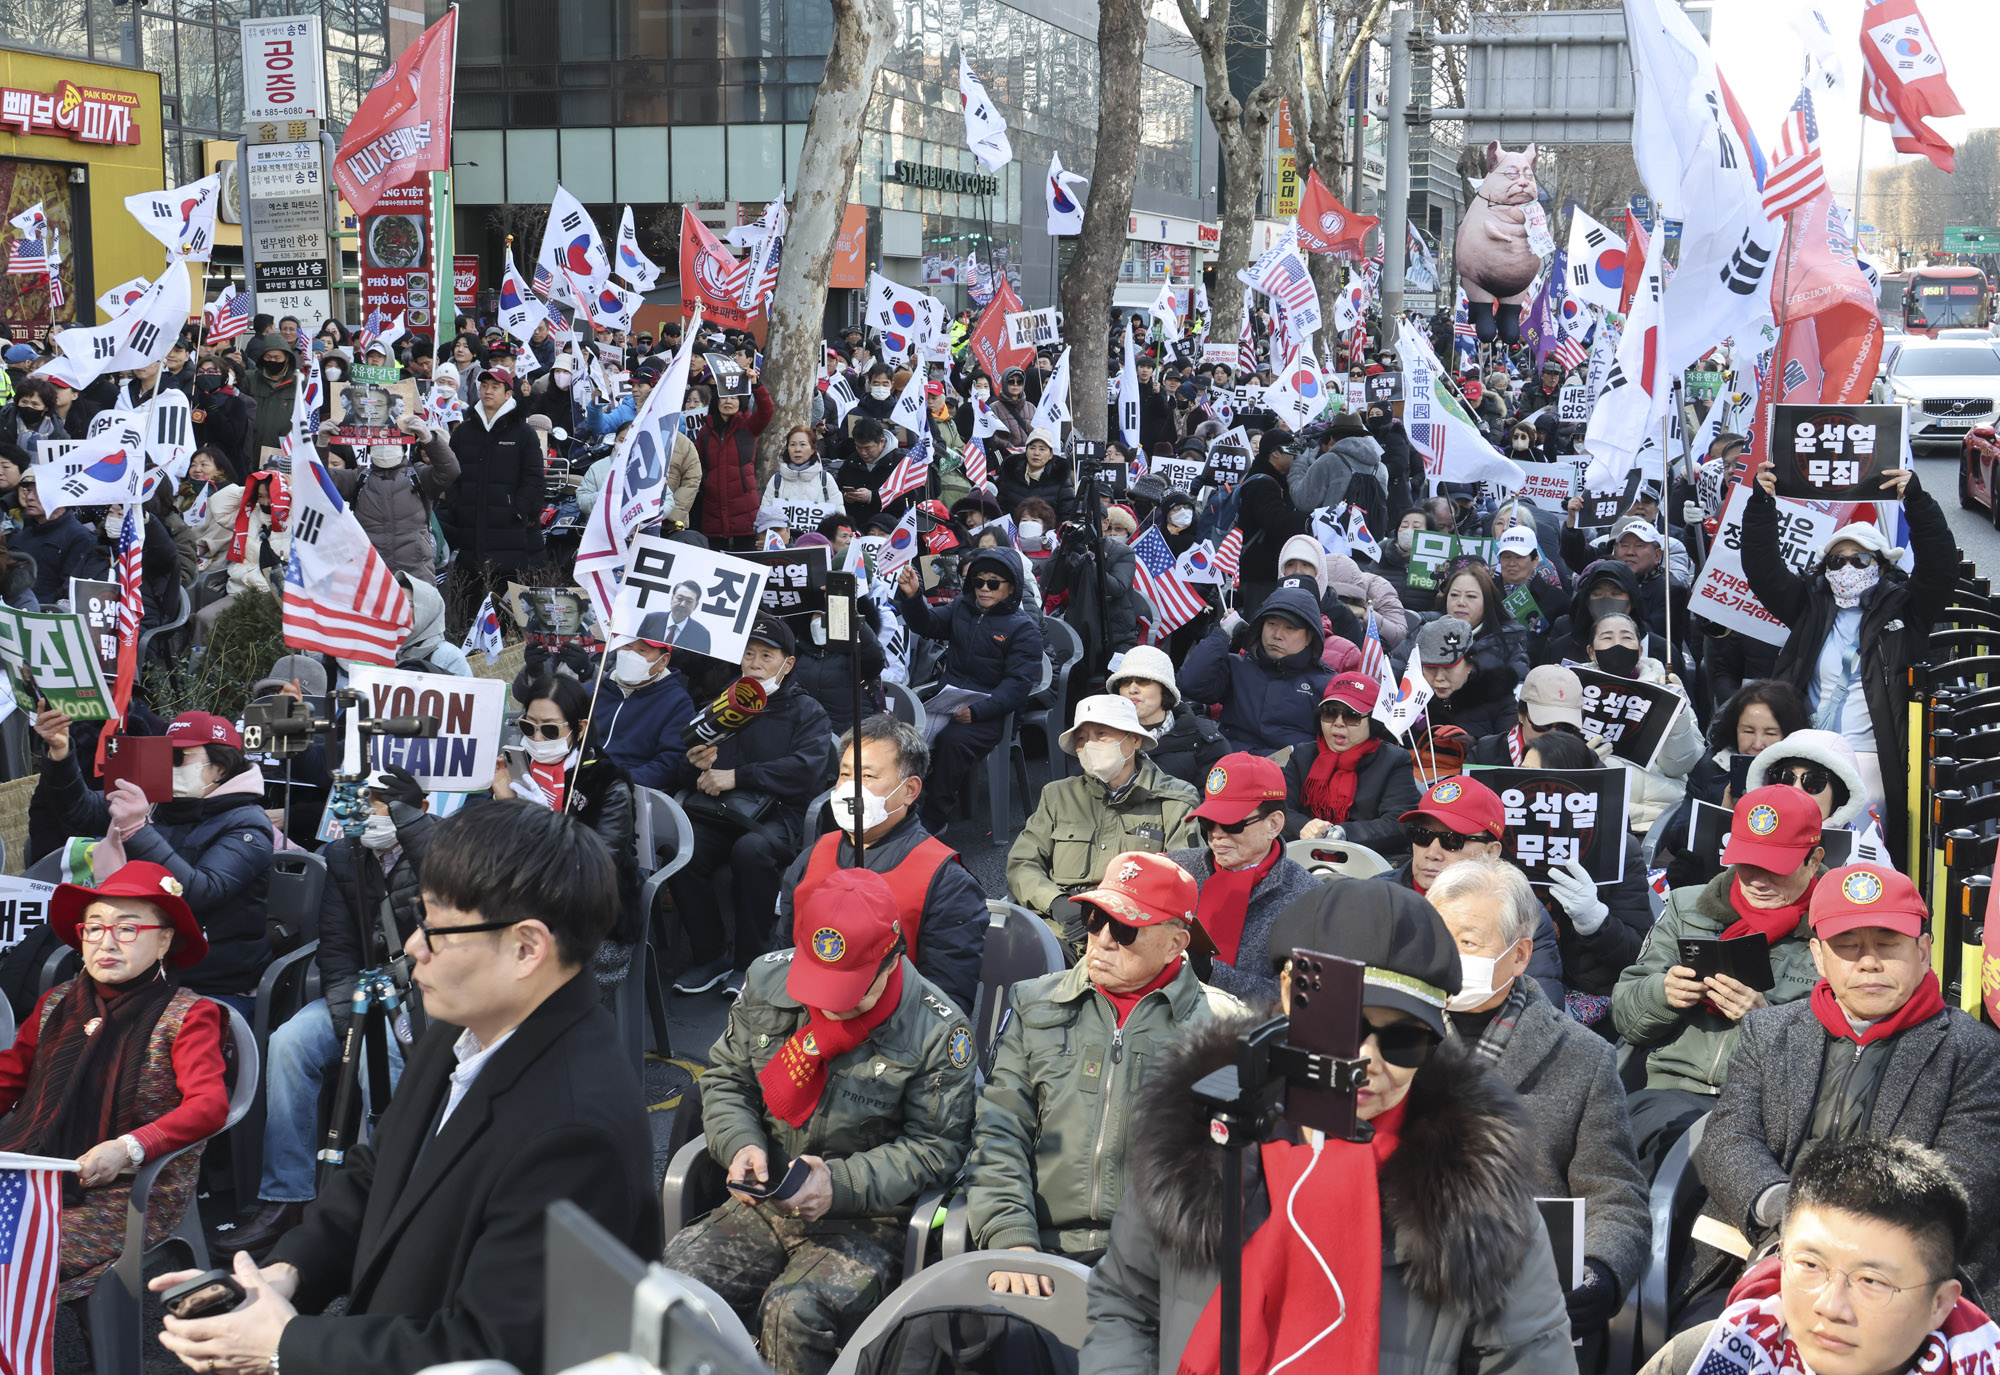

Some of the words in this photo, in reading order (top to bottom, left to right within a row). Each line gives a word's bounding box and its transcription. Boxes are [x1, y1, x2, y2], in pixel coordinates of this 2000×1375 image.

[287, 24, 306, 36] 송현
[264, 40, 296, 103] 공증
[84, 90, 100, 100] PAIK
[102, 92, 116, 102] BOY
[118, 94, 138, 104] PIZZA
[3, 90, 131, 142] 빽보이피자
[265, 107, 302, 116] 585-6080
[296, 170, 318, 184] 송현
[900, 160, 963, 192] STARBUCKS
[966, 171, 1000, 196] COFFEE
[1282, 170, 1296, 198] 임대
[402, 186, 424, 199] VIỆT
[260, 237, 295, 249] 법무법인
[297, 234, 318, 248] 한양
[262, 266, 294, 276] 법무법인
[296, 262, 322, 276] 삼승
[391, 274, 406, 287] BÒ
[280, 296, 299, 308] 원진
[304, 296, 312, 306] &
[391, 291, 406, 304] GÀ
[1016, 314, 1048, 331] YOON
[1016, 326, 1052, 345] AGAIN
[352, 365, 398, 380] 자유한길단
[1795, 422, 1876, 454] 윤석열
[356, 448, 369, 464] 계
[1210, 452, 1246, 470] 윤석열
[1160, 464, 1198, 480] 계엄은
[1214, 470, 1238, 484] 무죄
[1808, 460, 1859, 488] 무죄
[1541, 477, 1570, 488] 판사는
[782, 505, 824, 524] 계엄은
[1596, 502, 1618, 519] 무죄
[625, 546, 761, 635] 무죄
[1409, 574, 1434, 589] Free
[762, 590, 802, 609] 무죄
[88, 598, 120, 629] 윤석
[101, 634, 118, 661] 무죄
[50, 699, 104, 719] Yoon
[372, 683, 475, 735] YOON
[1582, 684, 1653, 723] 윤석열
[1584, 718, 1626, 743] 무죄
[1500, 788, 1598, 829] 윤석열
[1516, 834, 1580, 867] 무죄
[1782, 973, 1820, 988] PROP
[1720, 1327, 1764, 1367] YOON
